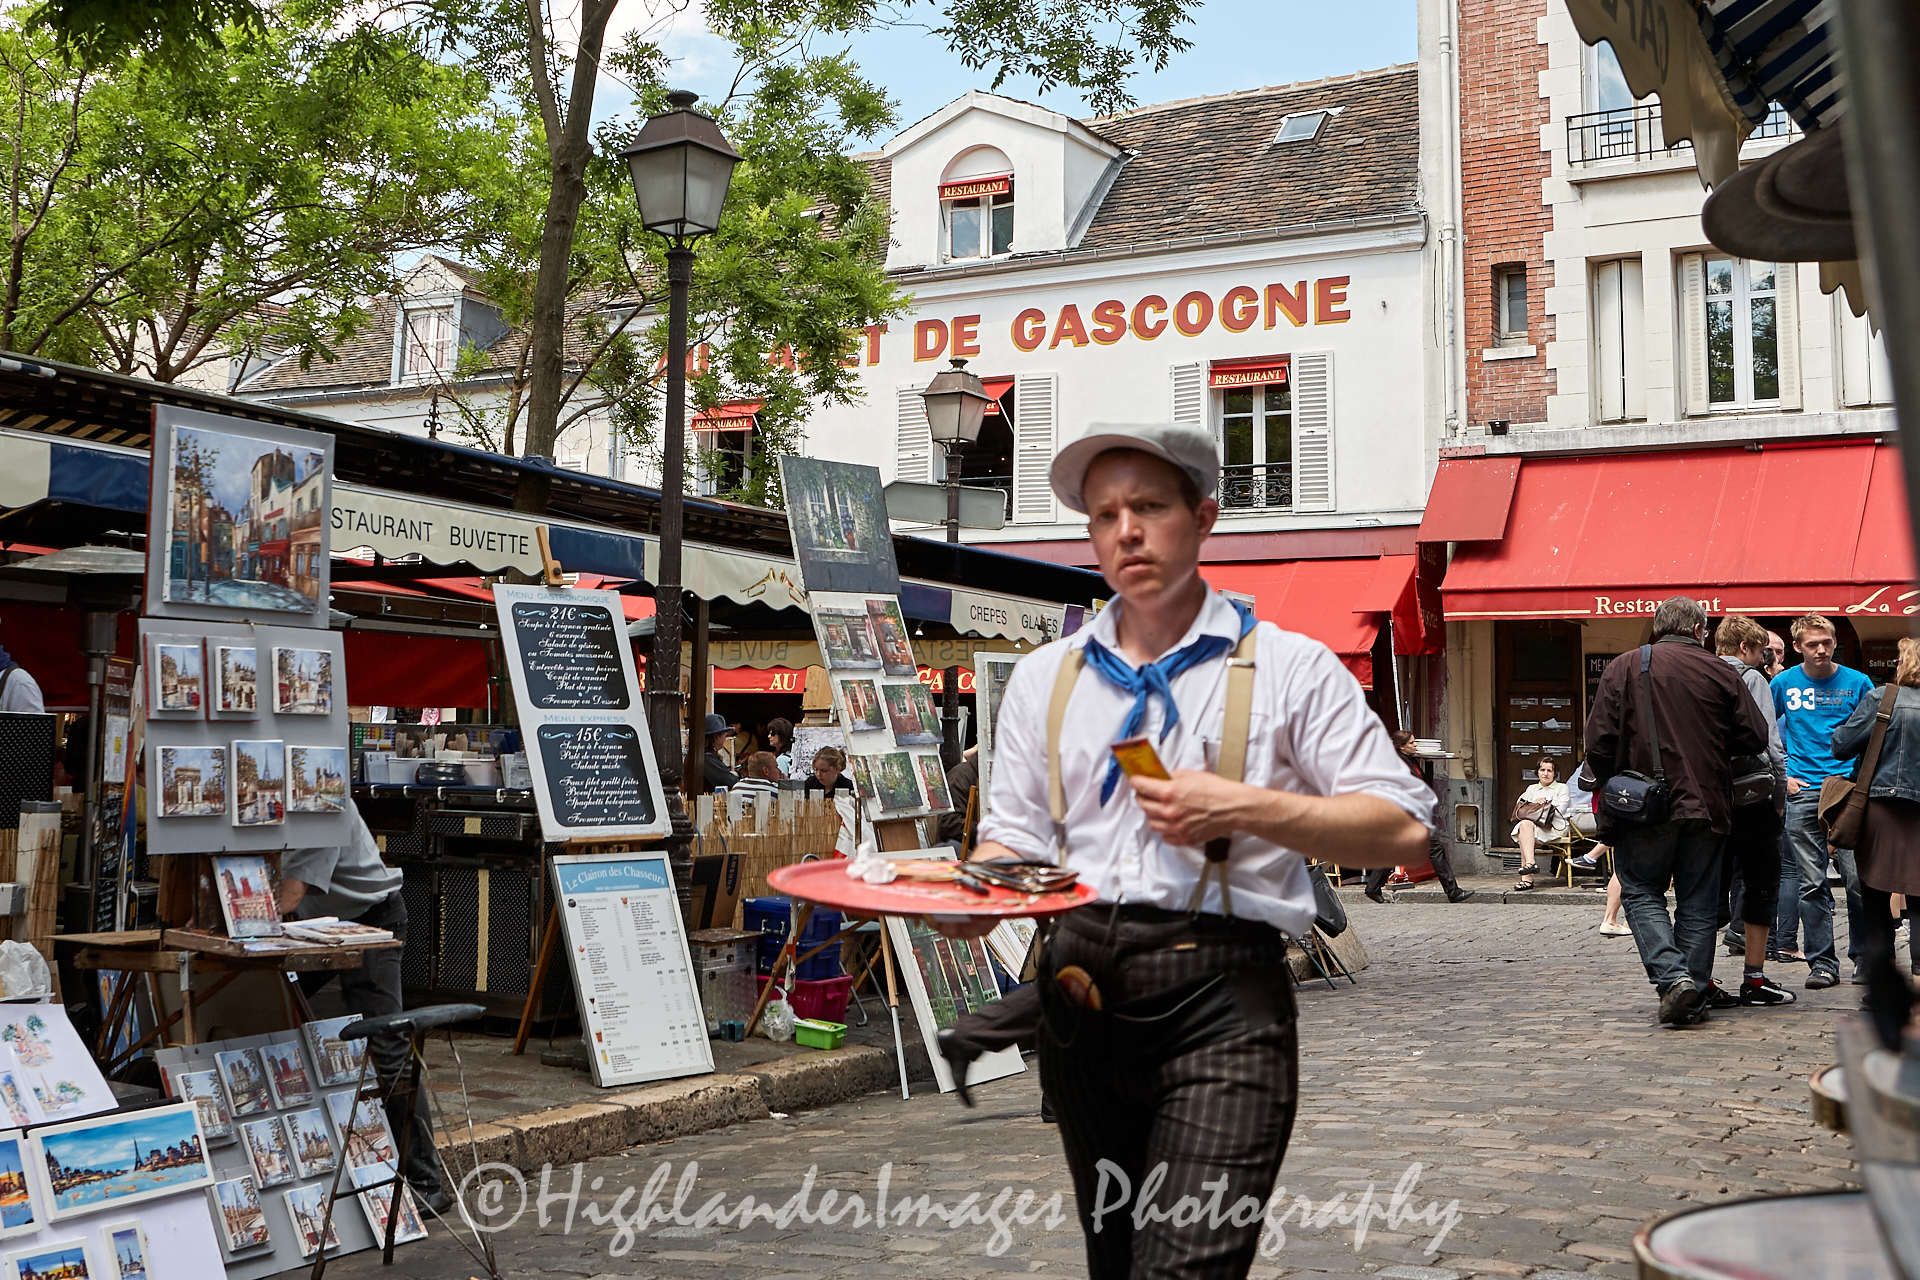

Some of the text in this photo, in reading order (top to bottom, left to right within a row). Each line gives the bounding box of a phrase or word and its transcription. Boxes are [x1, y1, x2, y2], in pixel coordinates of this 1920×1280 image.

[943, 180, 1005, 197] RESTAURANT
[914, 314, 981, 362] DE
[1010, 275, 1351, 352] GASCOGNE
[1214, 369, 1282, 385] RESTAURANT
[331, 507, 529, 555] STAURANT BUVETTE
[1594, 596, 1721, 615] Restant
[1845, 586, 1891, 613] La
[549, 606, 577, 620] 21€
[970, 604, 1058, 634] CREPES GLAES
[518, 617, 544, 631] Soupe
[538, 638, 567, 648] Salade
[568, 640, 576, 648] de
[549, 631, 587, 641] 6 escargots
[540, 648, 574, 658] Tomates
[575, 650, 614, 659] mozzarella
[595, 664, 619, 675] poivre
[1869, 659, 1886, 668] Salle
[545, 671, 609, 684] Confit de canard
[769, 667, 976, 691] AU GAC
[556, 681, 603, 694] Plat du jour
[542, 694, 580, 708] Fromage
[592, 694, 621, 706] Dessert
[1786, 687, 1816, 711] 33
[576, 727, 603, 742] 15€
[560, 740, 585, 753] Soupe
[581, 751, 590, 760] de
[591, 753, 628, 763] campagne
[571, 760, 621, 770] Salade mixte
[559, 775, 640, 789] Faux filet grillé frites
[593, 787, 638, 798] bourguignon
[565, 796, 641, 810] Spaghetti bolognaise
[567, 812, 606, 825] Fromage
[618, 811, 647, 822] Dessert
[565, 879, 579, 892] Le
[577, 869, 607, 884] Clairon
[609, 866, 622, 877] des
[624, 865, 666, 886] Chasseurs
